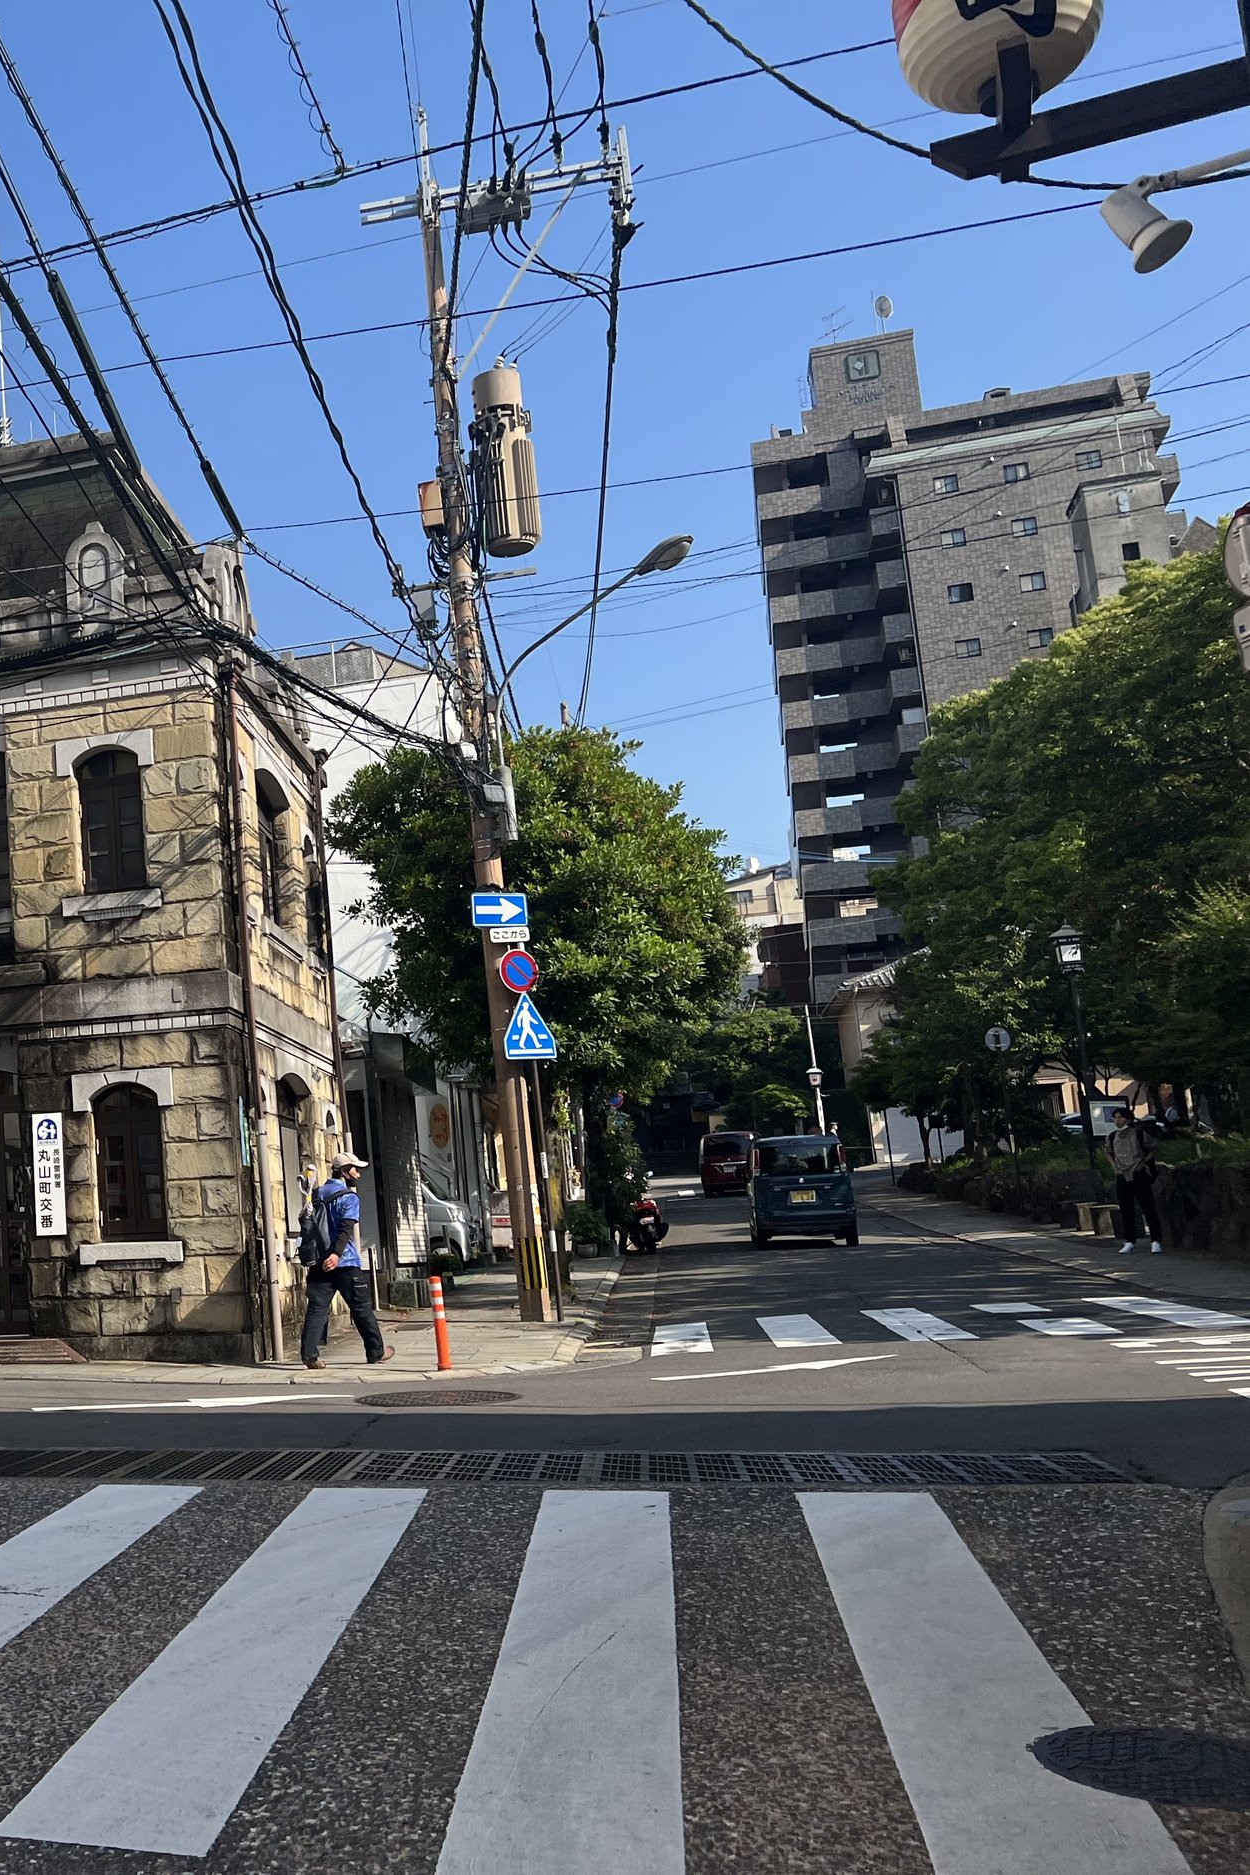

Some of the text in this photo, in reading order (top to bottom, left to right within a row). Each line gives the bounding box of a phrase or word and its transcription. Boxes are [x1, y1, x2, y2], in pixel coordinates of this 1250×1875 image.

[493, 930, 527, 940] ここから
[38, 1149, 53, 1228] 丸山町交番
